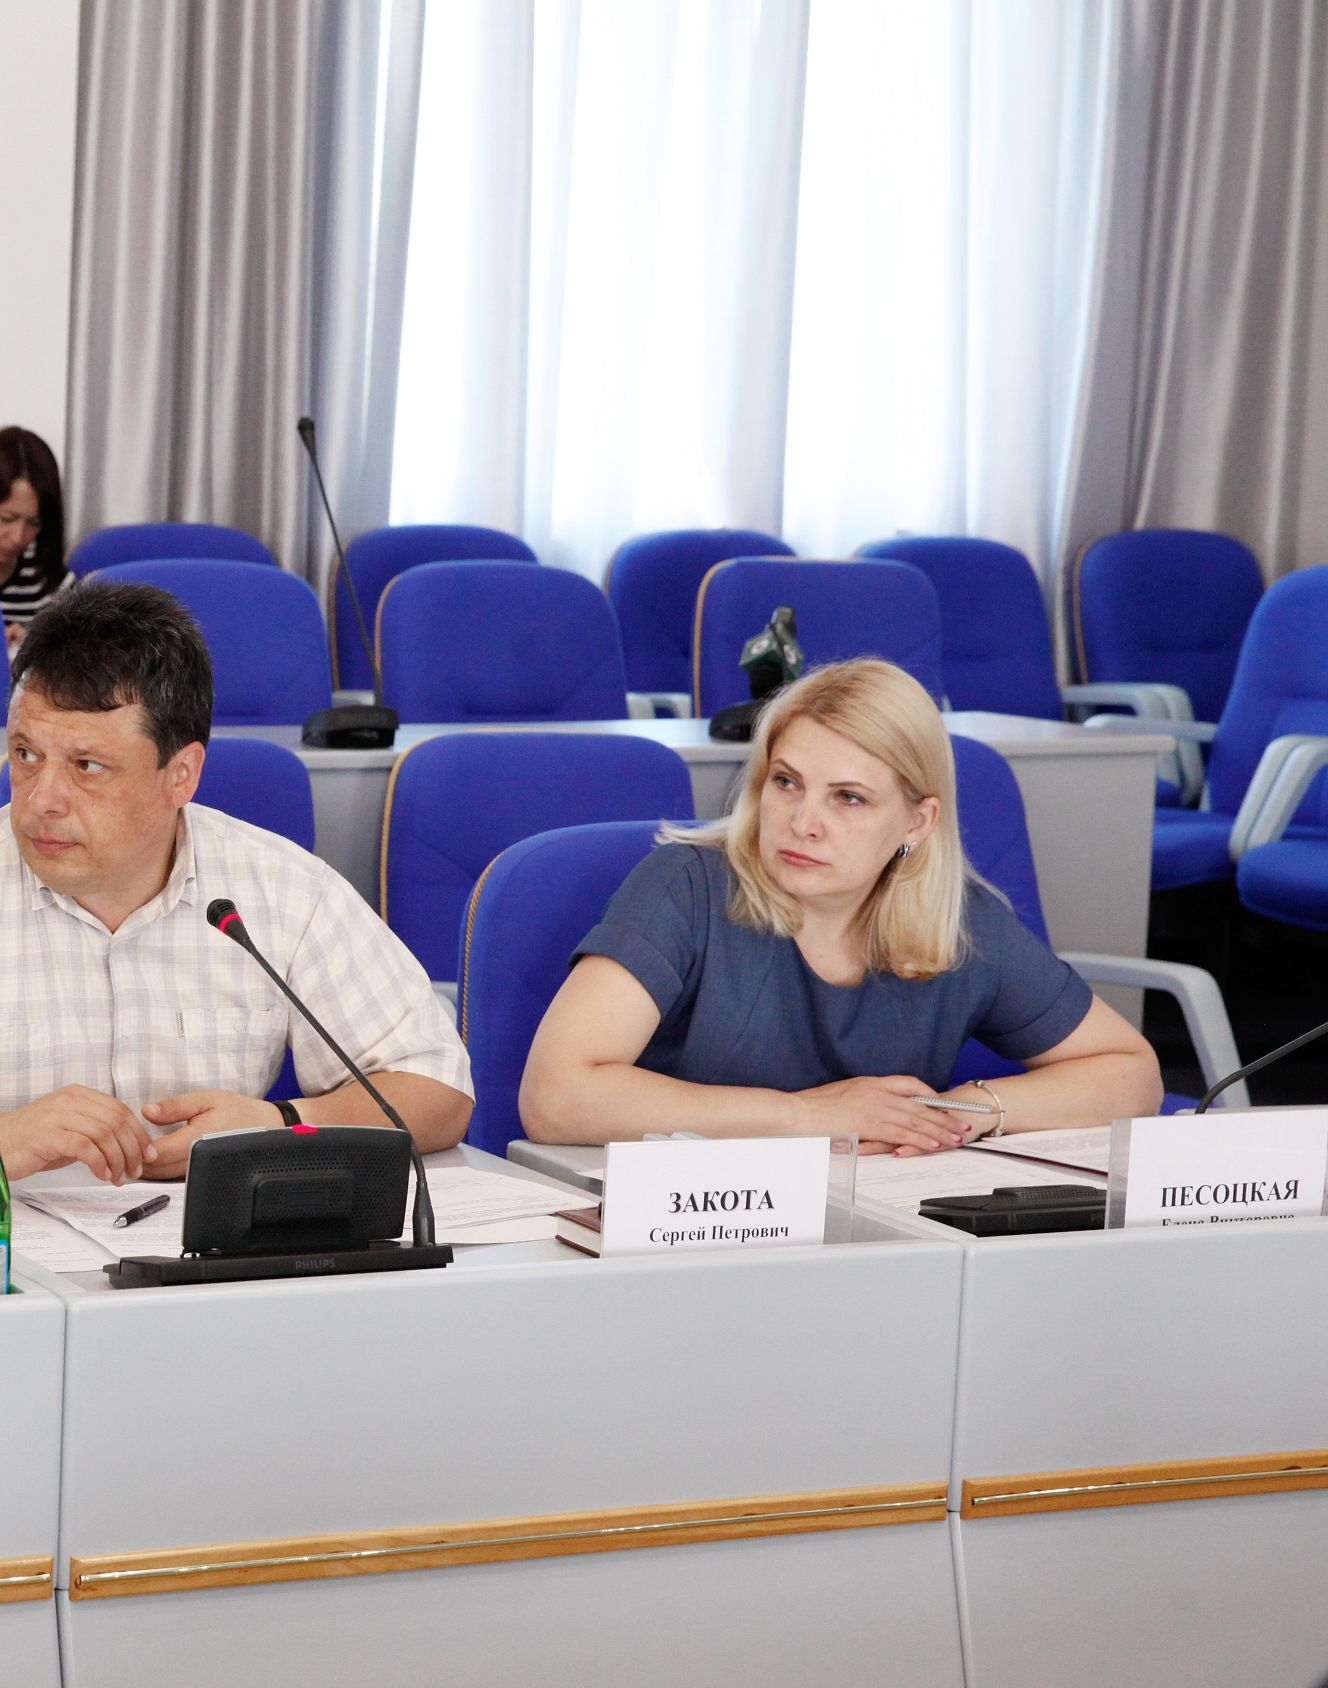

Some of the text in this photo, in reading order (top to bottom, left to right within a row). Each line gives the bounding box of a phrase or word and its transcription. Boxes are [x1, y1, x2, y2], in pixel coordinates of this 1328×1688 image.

[668, 1189, 775, 1214] ЗАКОТА
[1160, 1179, 1300, 1208] ПЕСОЦКАЯ
[649, 1225, 790, 1246] Сергей Петрович
[295, 1259, 336, 1270] PHILIPS
